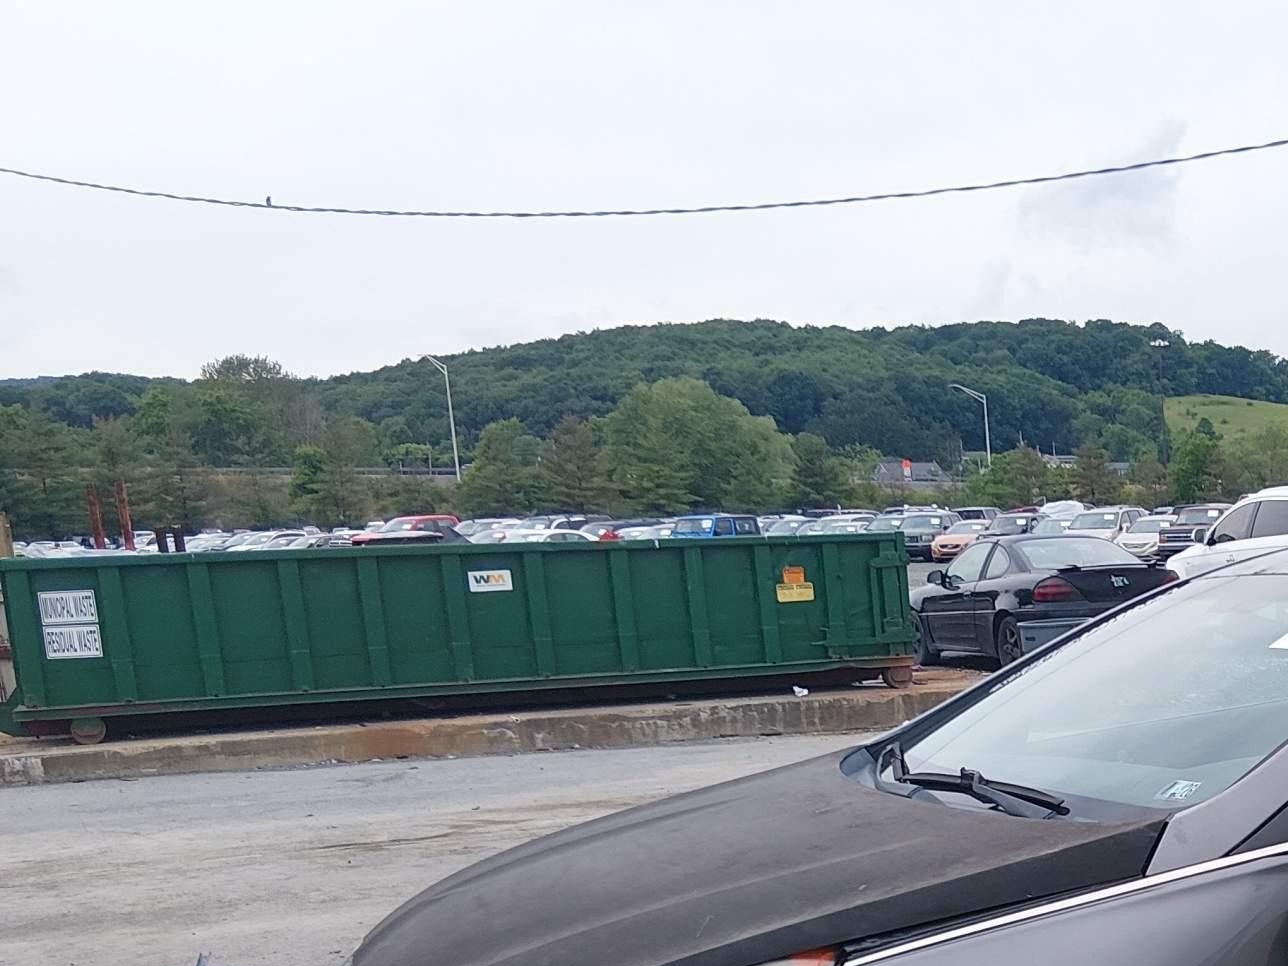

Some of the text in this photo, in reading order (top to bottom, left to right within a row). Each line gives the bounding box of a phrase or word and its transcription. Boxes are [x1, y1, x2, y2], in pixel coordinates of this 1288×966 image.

[473, 575, 506, 584] WM
[72, 595, 94, 617] WASTE
[46, 629, 99, 653] RESIDUAL WASTE
